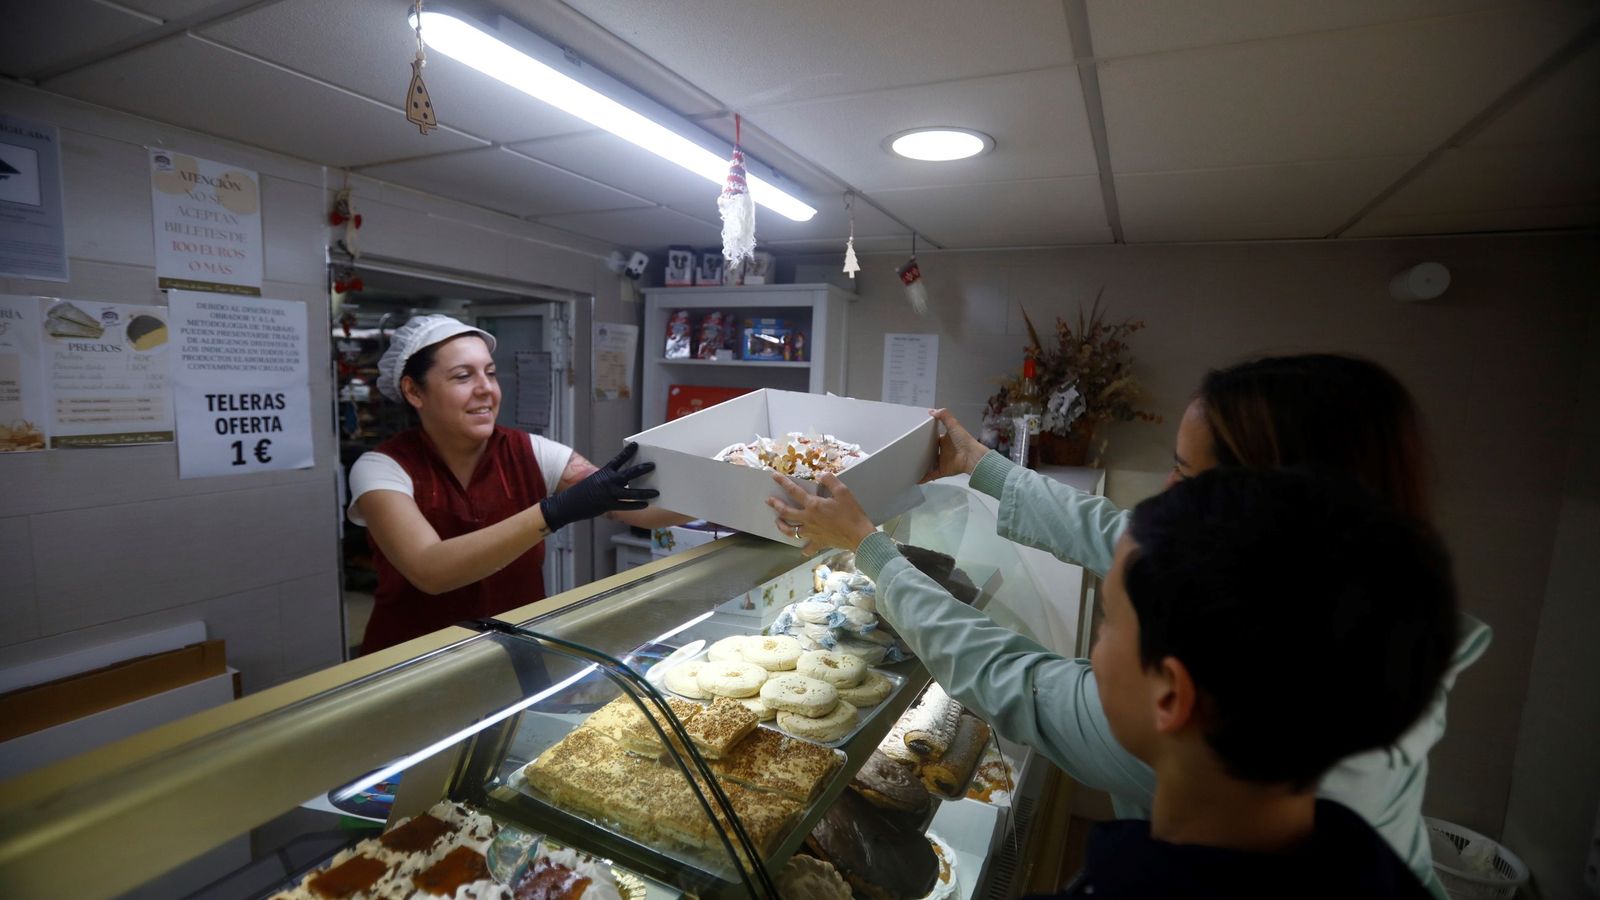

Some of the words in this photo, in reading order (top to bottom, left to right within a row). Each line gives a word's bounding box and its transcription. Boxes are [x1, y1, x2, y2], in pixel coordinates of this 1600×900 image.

[178, 170, 242, 192] ATENCIÓN
[185, 188, 206, 202] NO
[209, 194, 224, 205] SE
[176, 205, 239, 225] ACEPTAN
[165, 221, 228, 240] BILLETES
[230, 231, 249, 243] DE
[172, 240, 198, 252] 100
[200, 244, 246, 259] EUROS
[188, 260, 201, 271] O
[196, 302, 229, 311] DEBIDO
[272, 308, 286, 316] DEL
[209, 312, 250, 321] OBRADOR
[180, 327, 215, 336] PUEDEN
[216, 329, 270, 339] PRESENTARSE
[271, 332, 300, 341] TRAZAS
[249, 323, 260, 331] DE
[261, 324, 295, 333] TRABAJO
[68, 342, 123, 353] PRECIOS
[186, 337, 198, 345] DE
[182, 345, 199, 353] LOS
[200, 346, 246, 355] INDICADOS
[247, 348, 259, 356] EN
[182, 354, 232, 362] PRODUCTOS
[233, 355, 284, 364] ELABORADOS
[205, 393, 286, 412] TELERAS
[215, 415, 283, 435] OFERTA
[231, 440, 247, 466] 1
[253, 438, 273, 464] €
